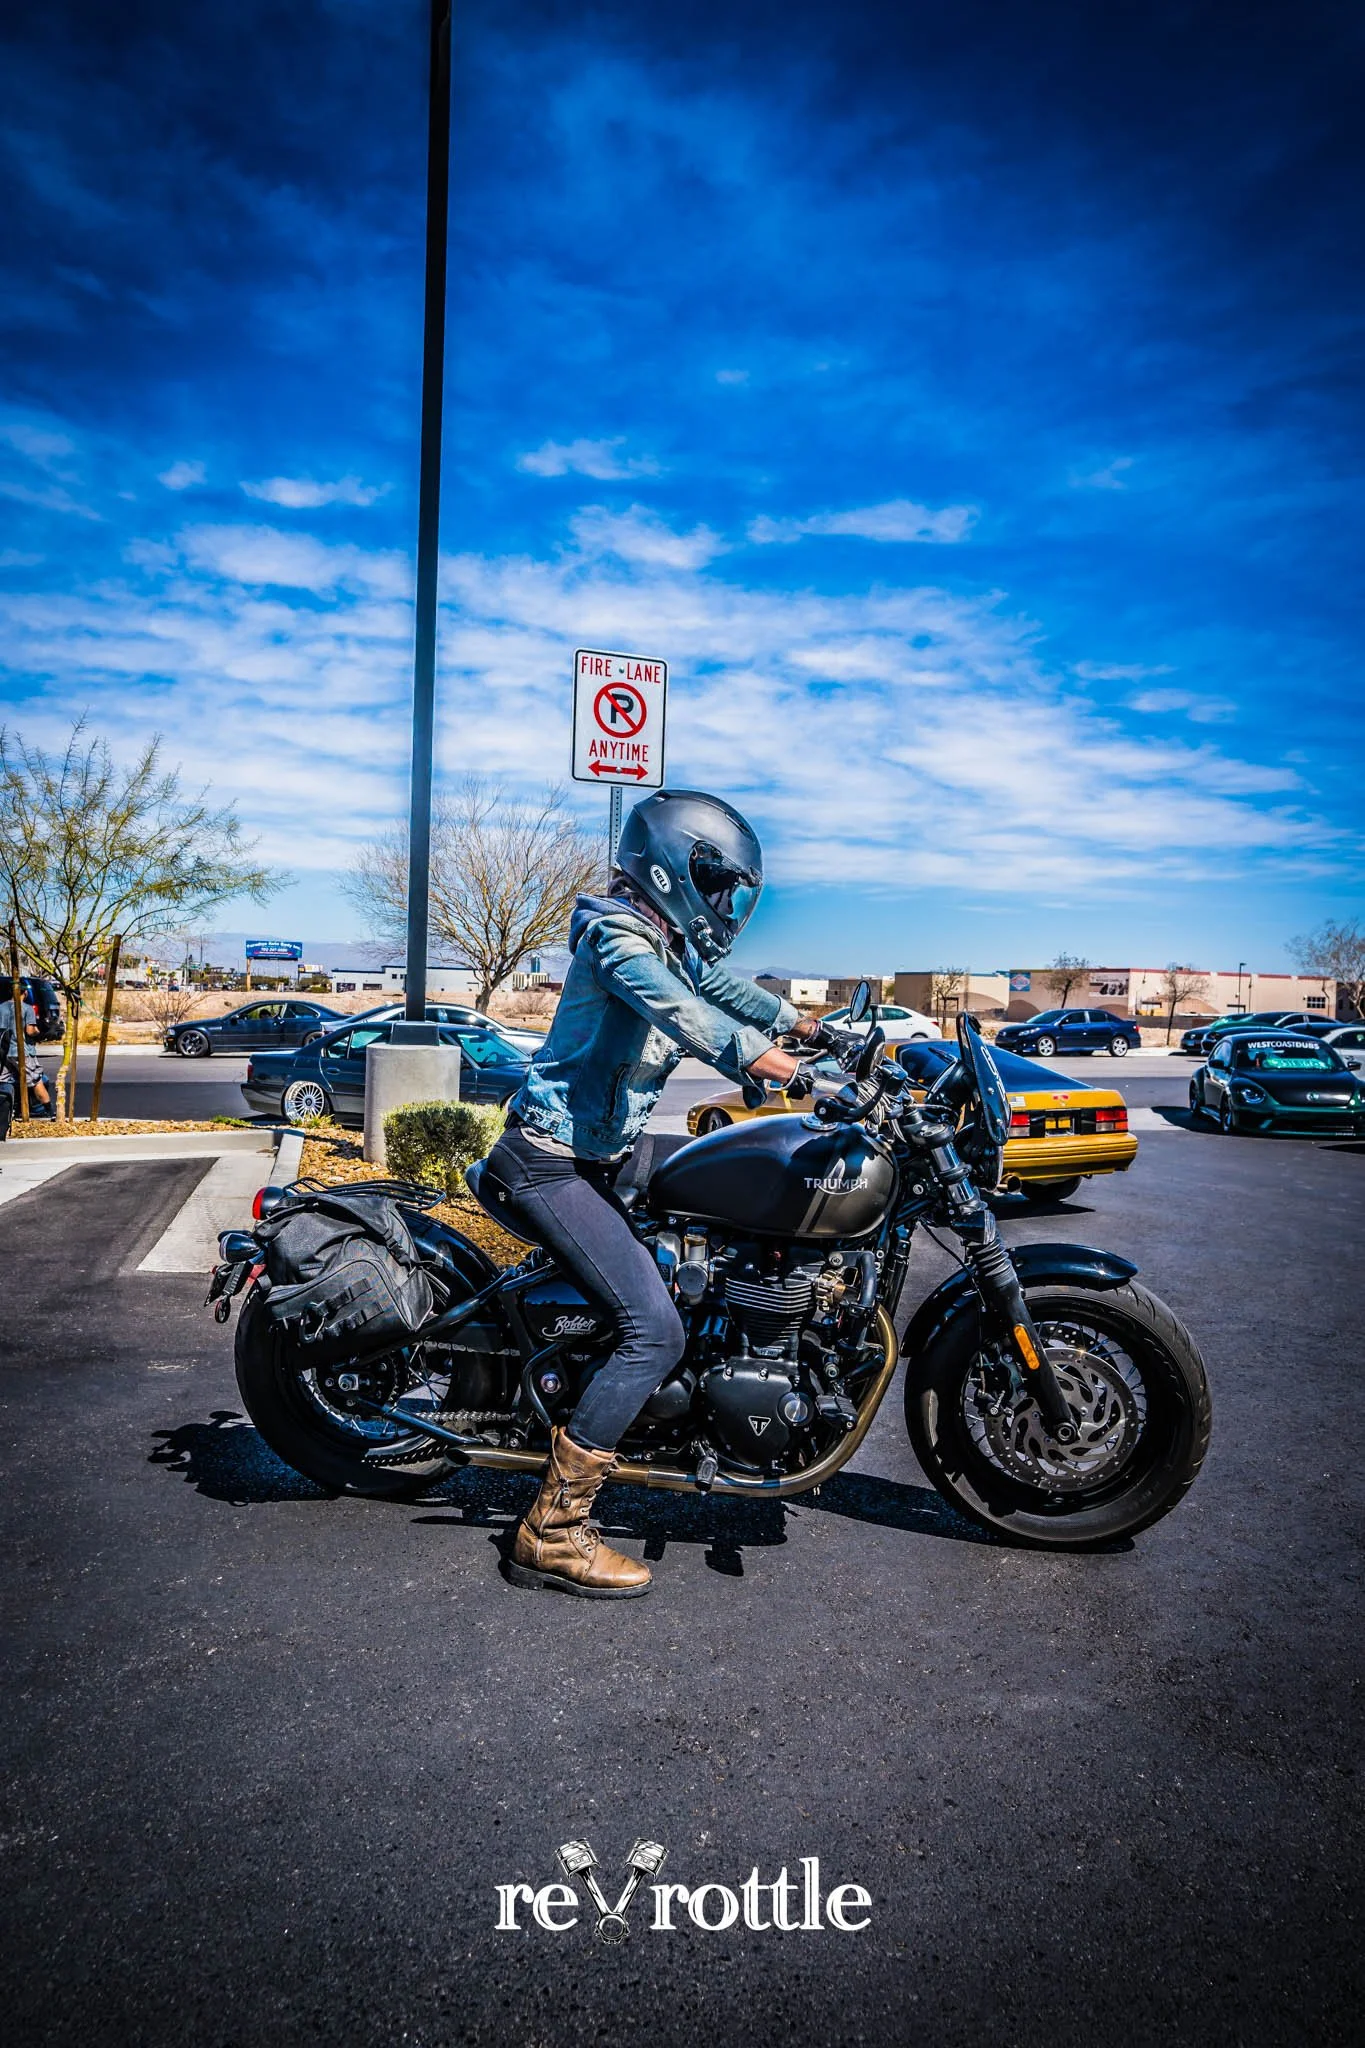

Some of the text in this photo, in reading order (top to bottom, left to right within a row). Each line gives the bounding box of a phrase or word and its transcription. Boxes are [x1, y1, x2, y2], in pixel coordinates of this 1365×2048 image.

[581, 656, 661, 683] FIRE LANE
[588, 739, 649, 762] ANYTIME
[653, 869, 668, 889] BELL
[1247, 1041, 1320, 1050] WESTCOASTDUBS
[803, 1177, 868, 1190] TRIUMPH
[542, 1315, 596, 1336] Bobber
